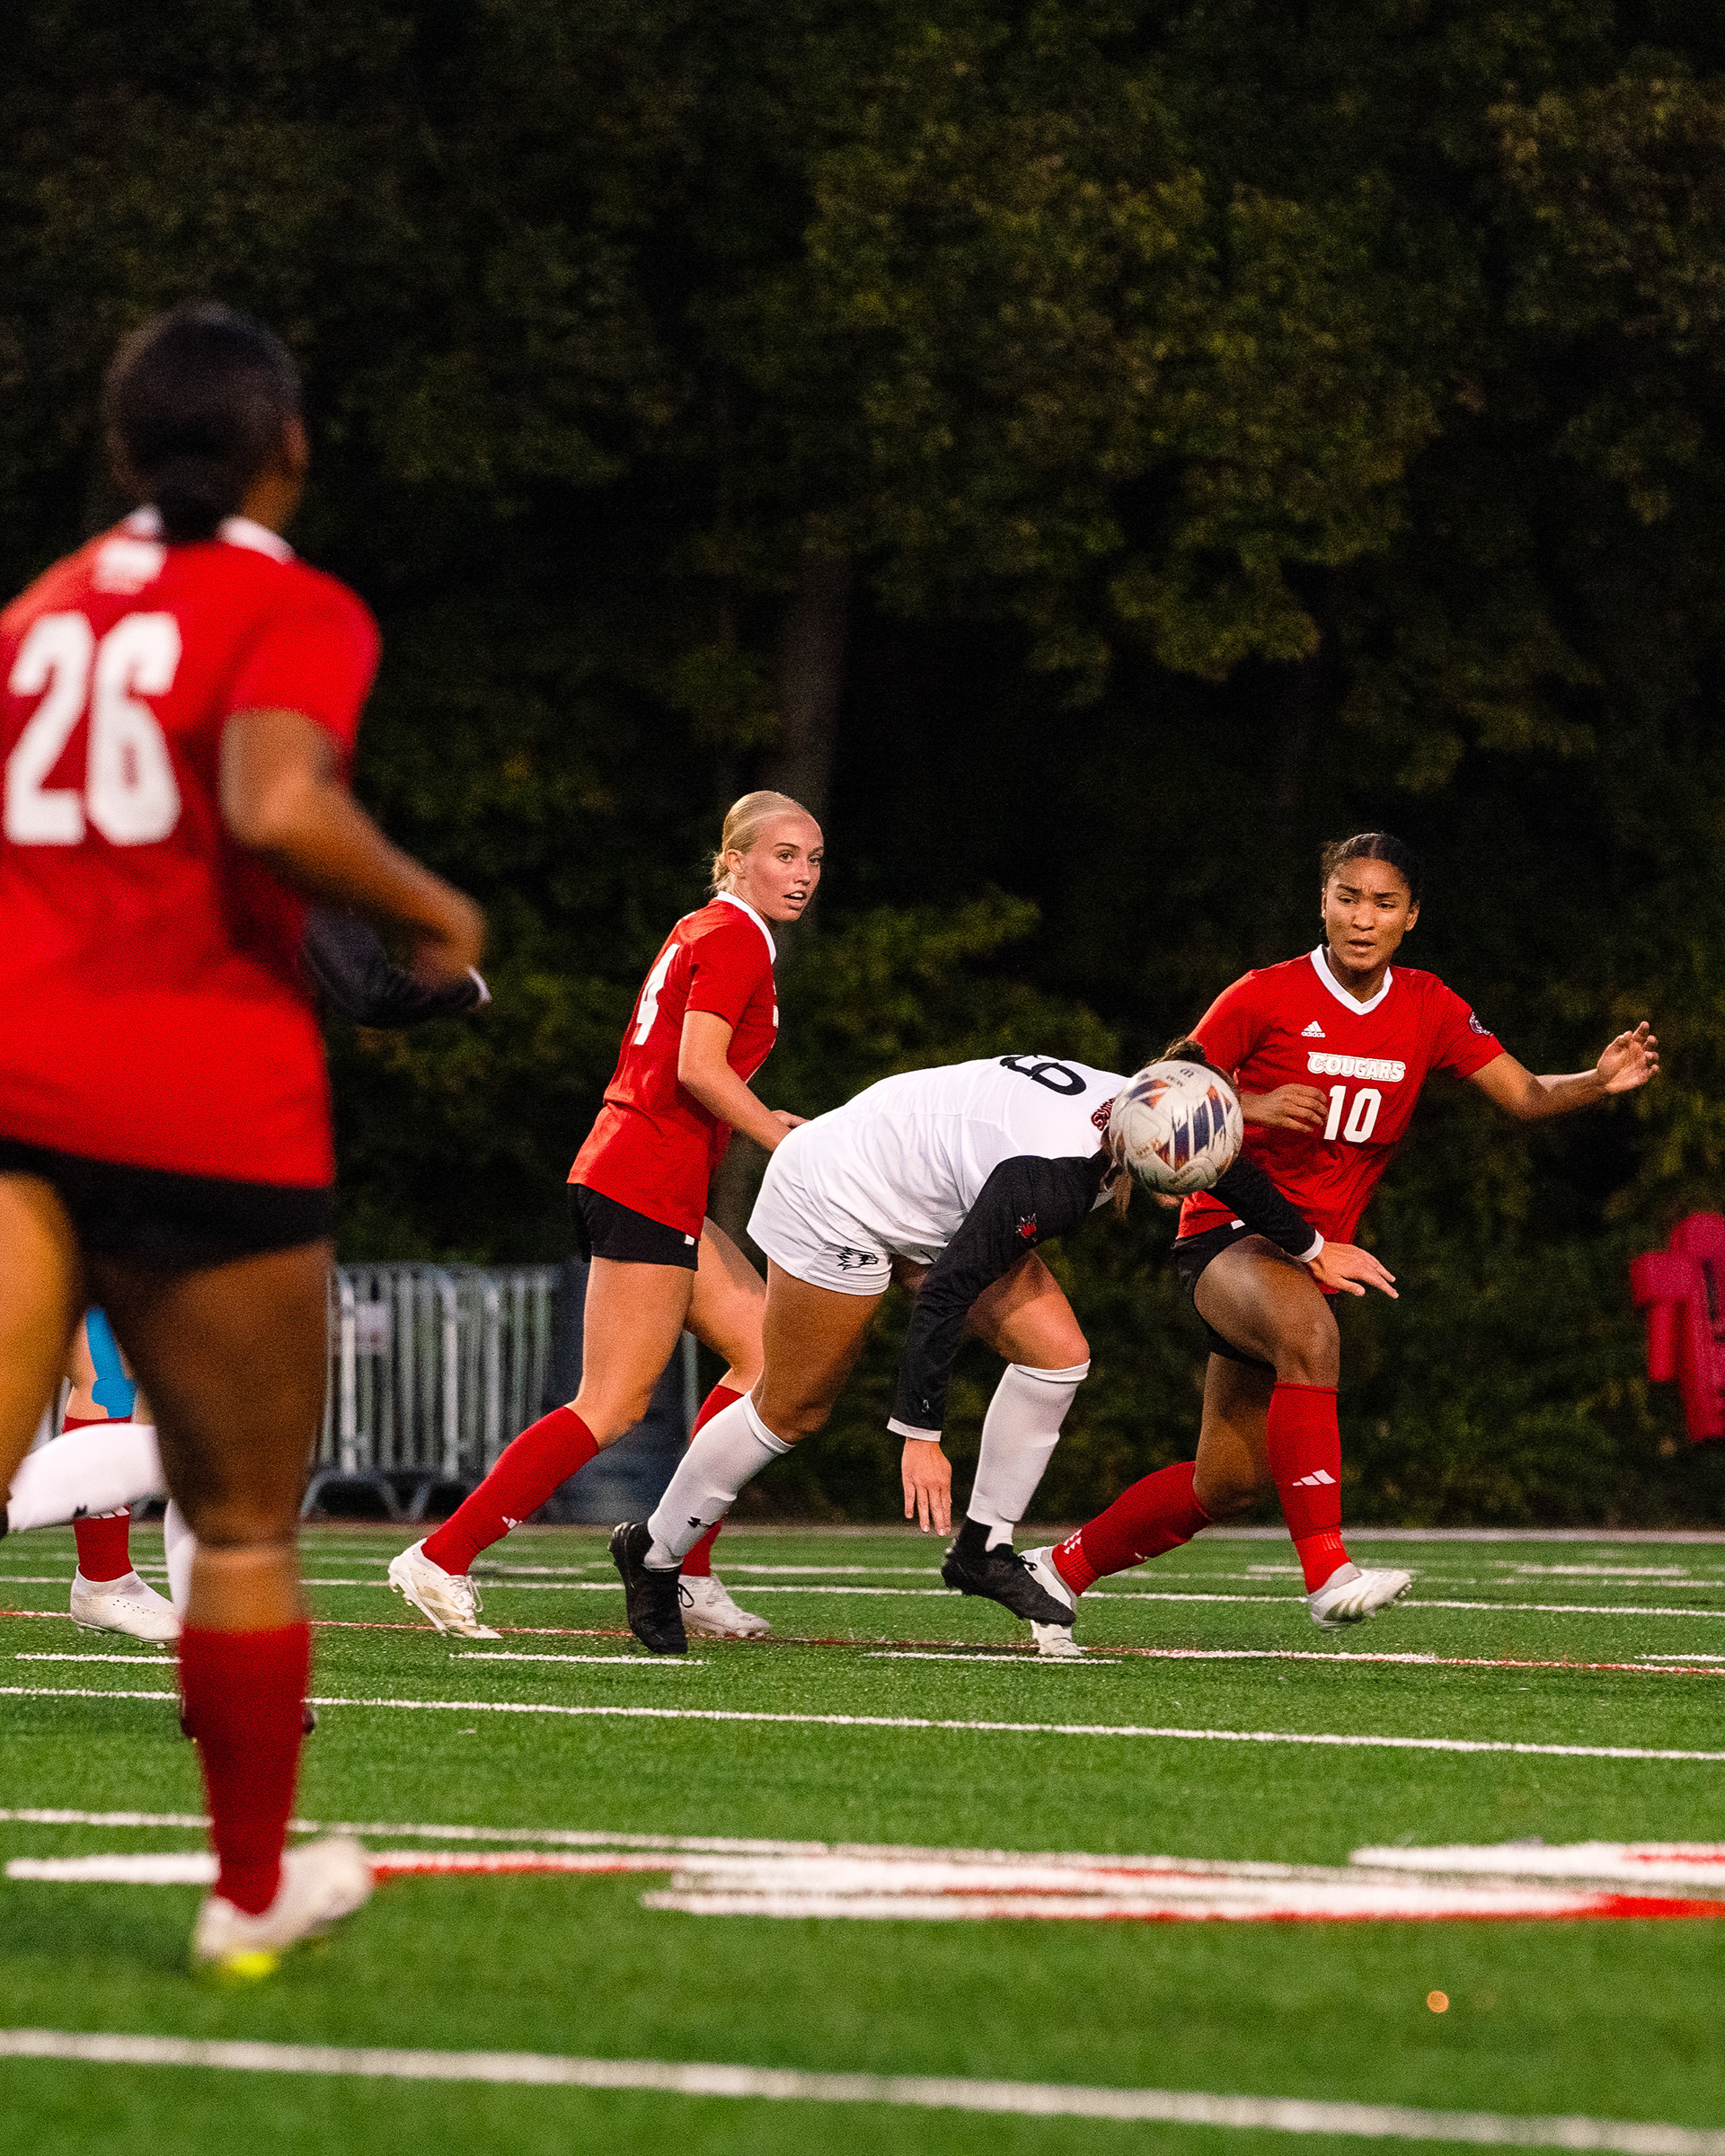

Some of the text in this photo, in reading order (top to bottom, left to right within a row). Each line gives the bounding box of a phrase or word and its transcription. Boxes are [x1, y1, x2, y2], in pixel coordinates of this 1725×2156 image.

[4, 612, 181, 846] 26
[1307, 1051, 1407, 1082] COUGARS
[1323, 1085, 1382, 1143] 10
